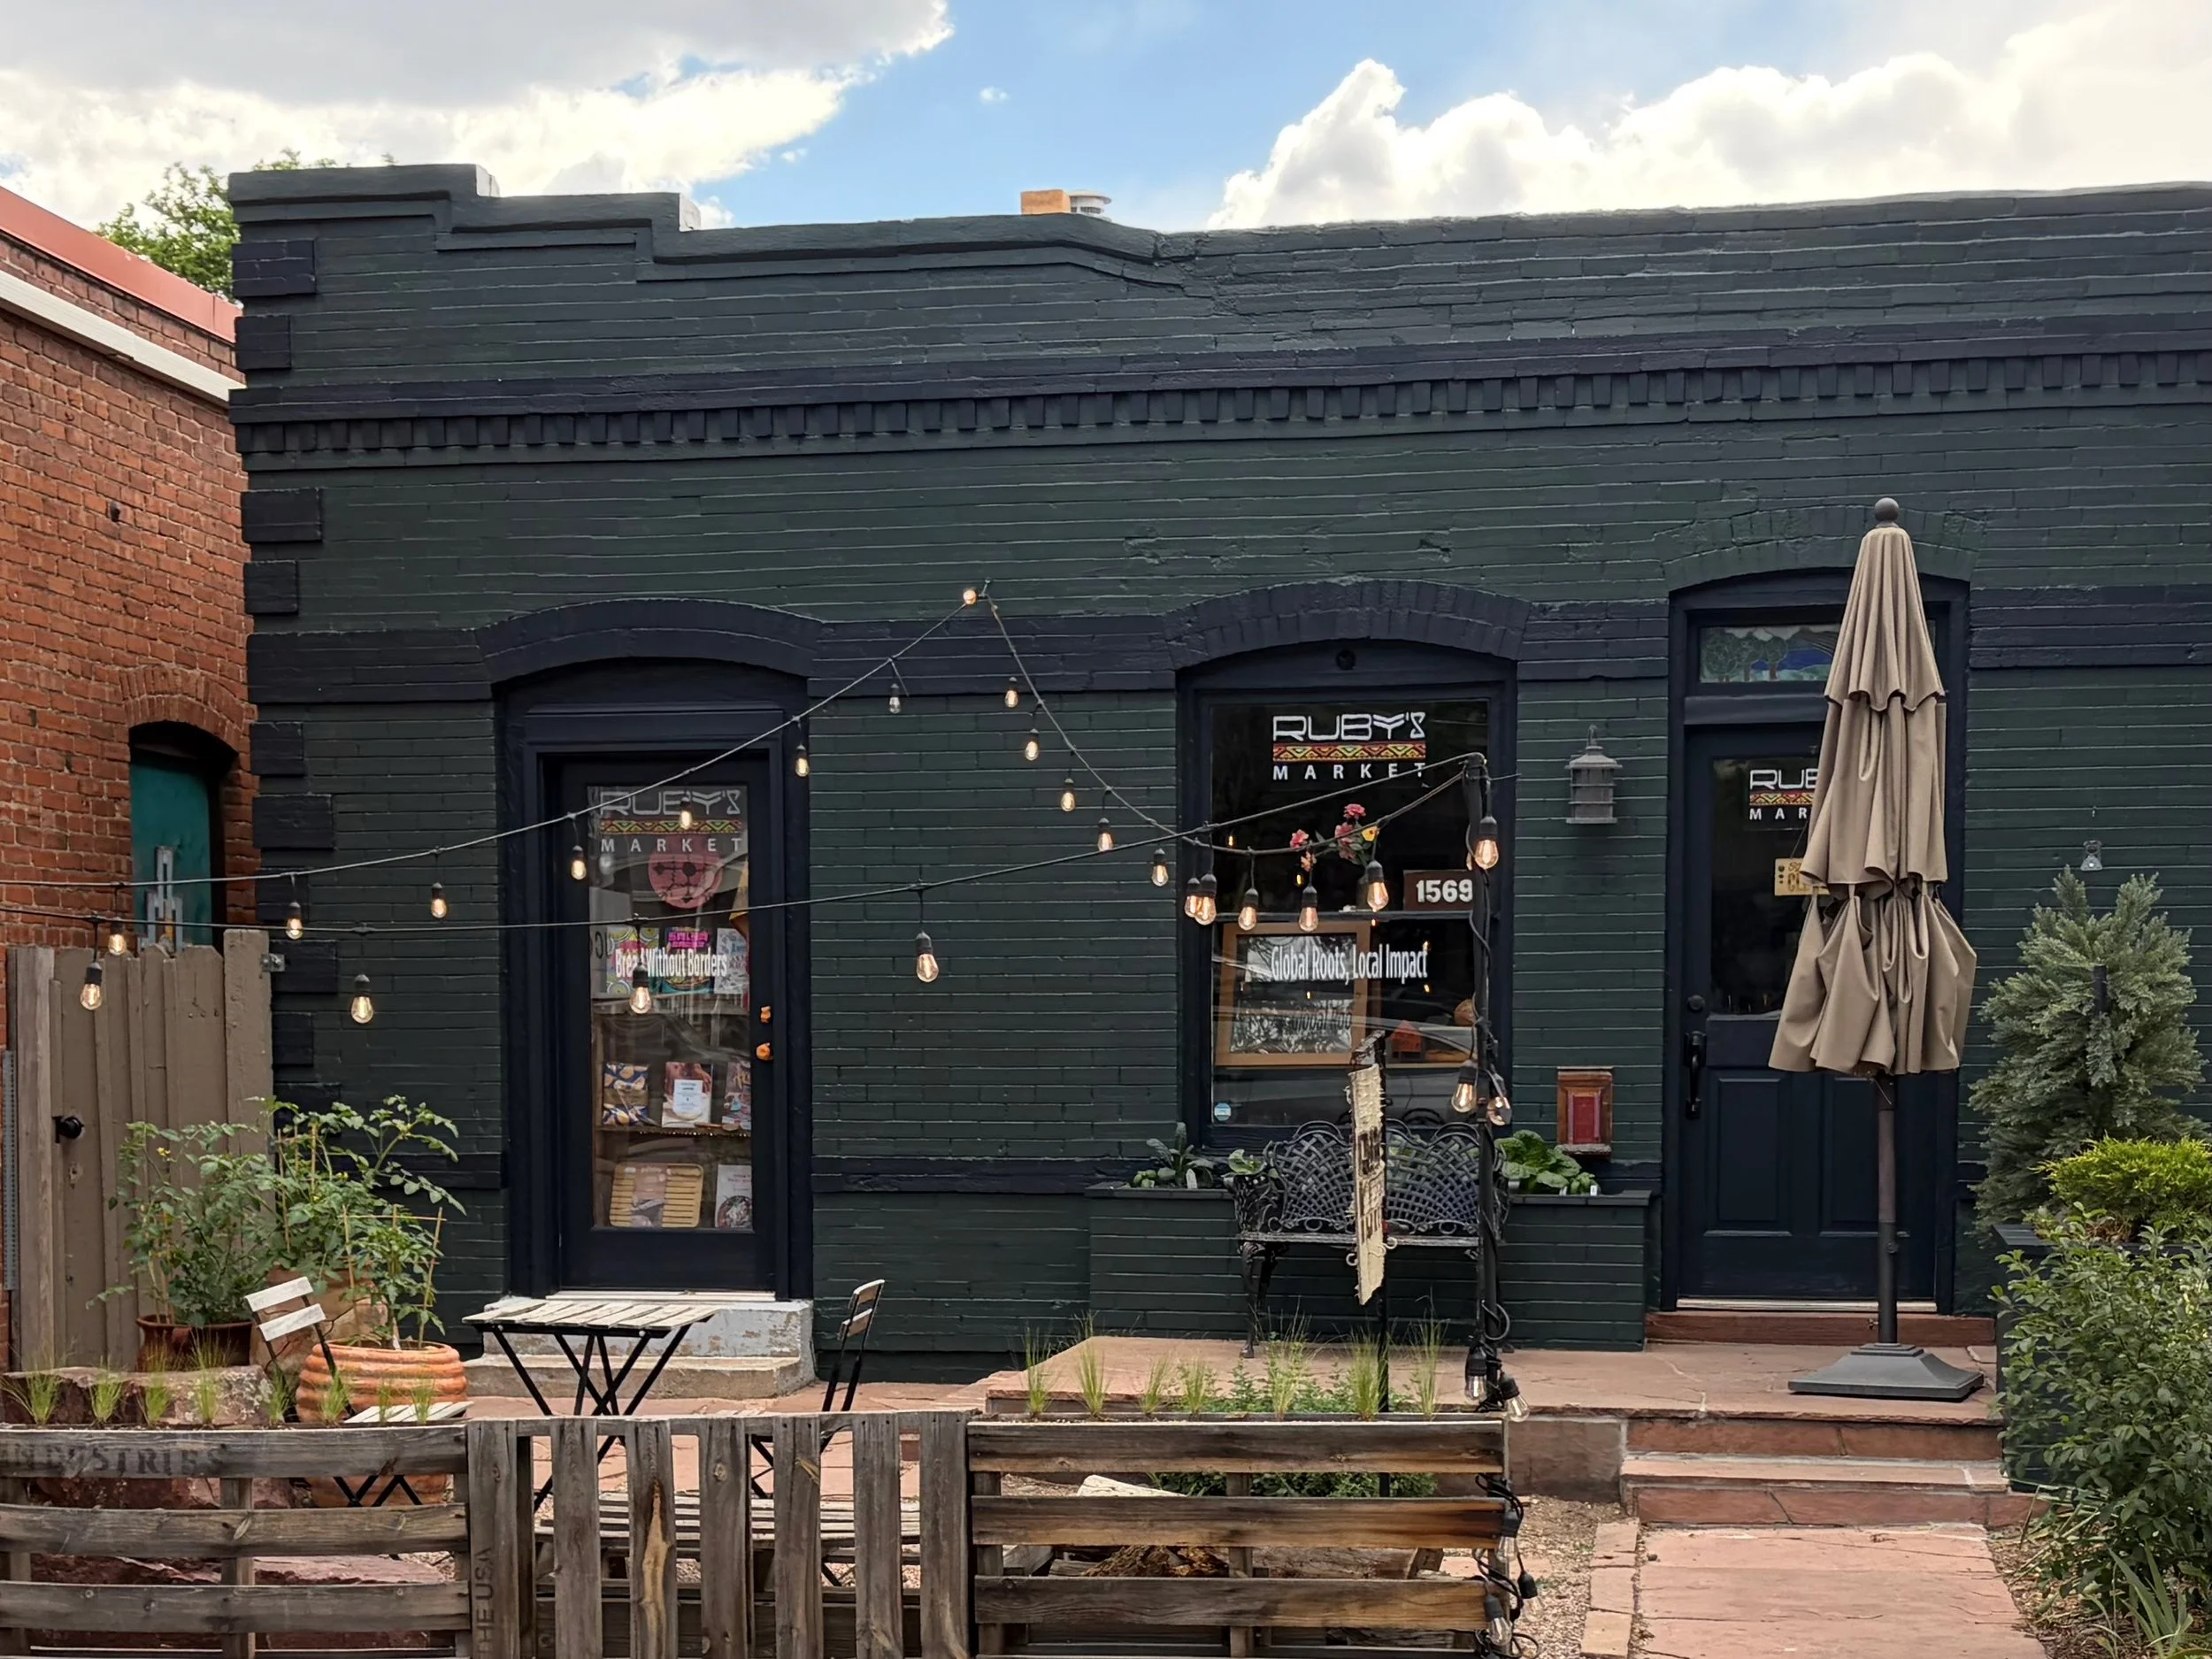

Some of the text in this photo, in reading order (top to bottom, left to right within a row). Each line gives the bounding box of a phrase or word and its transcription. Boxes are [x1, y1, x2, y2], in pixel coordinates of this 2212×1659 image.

[1272, 711, 1426, 741] RUBY'S
[1272, 763, 1426, 780] MARKET
[600, 789, 741, 816] RUBY'S
[1748, 807, 1808, 821] MAR
[600, 838, 742, 853] MARKET
[1416, 879, 1473, 903] 1569
[646, 946, 686, 978] Without
[687, 946, 728, 978] Borders
[1271, 943, 1429, 986] Global Roots, Local Impact
[474, 1547, 495, 1601] USA
